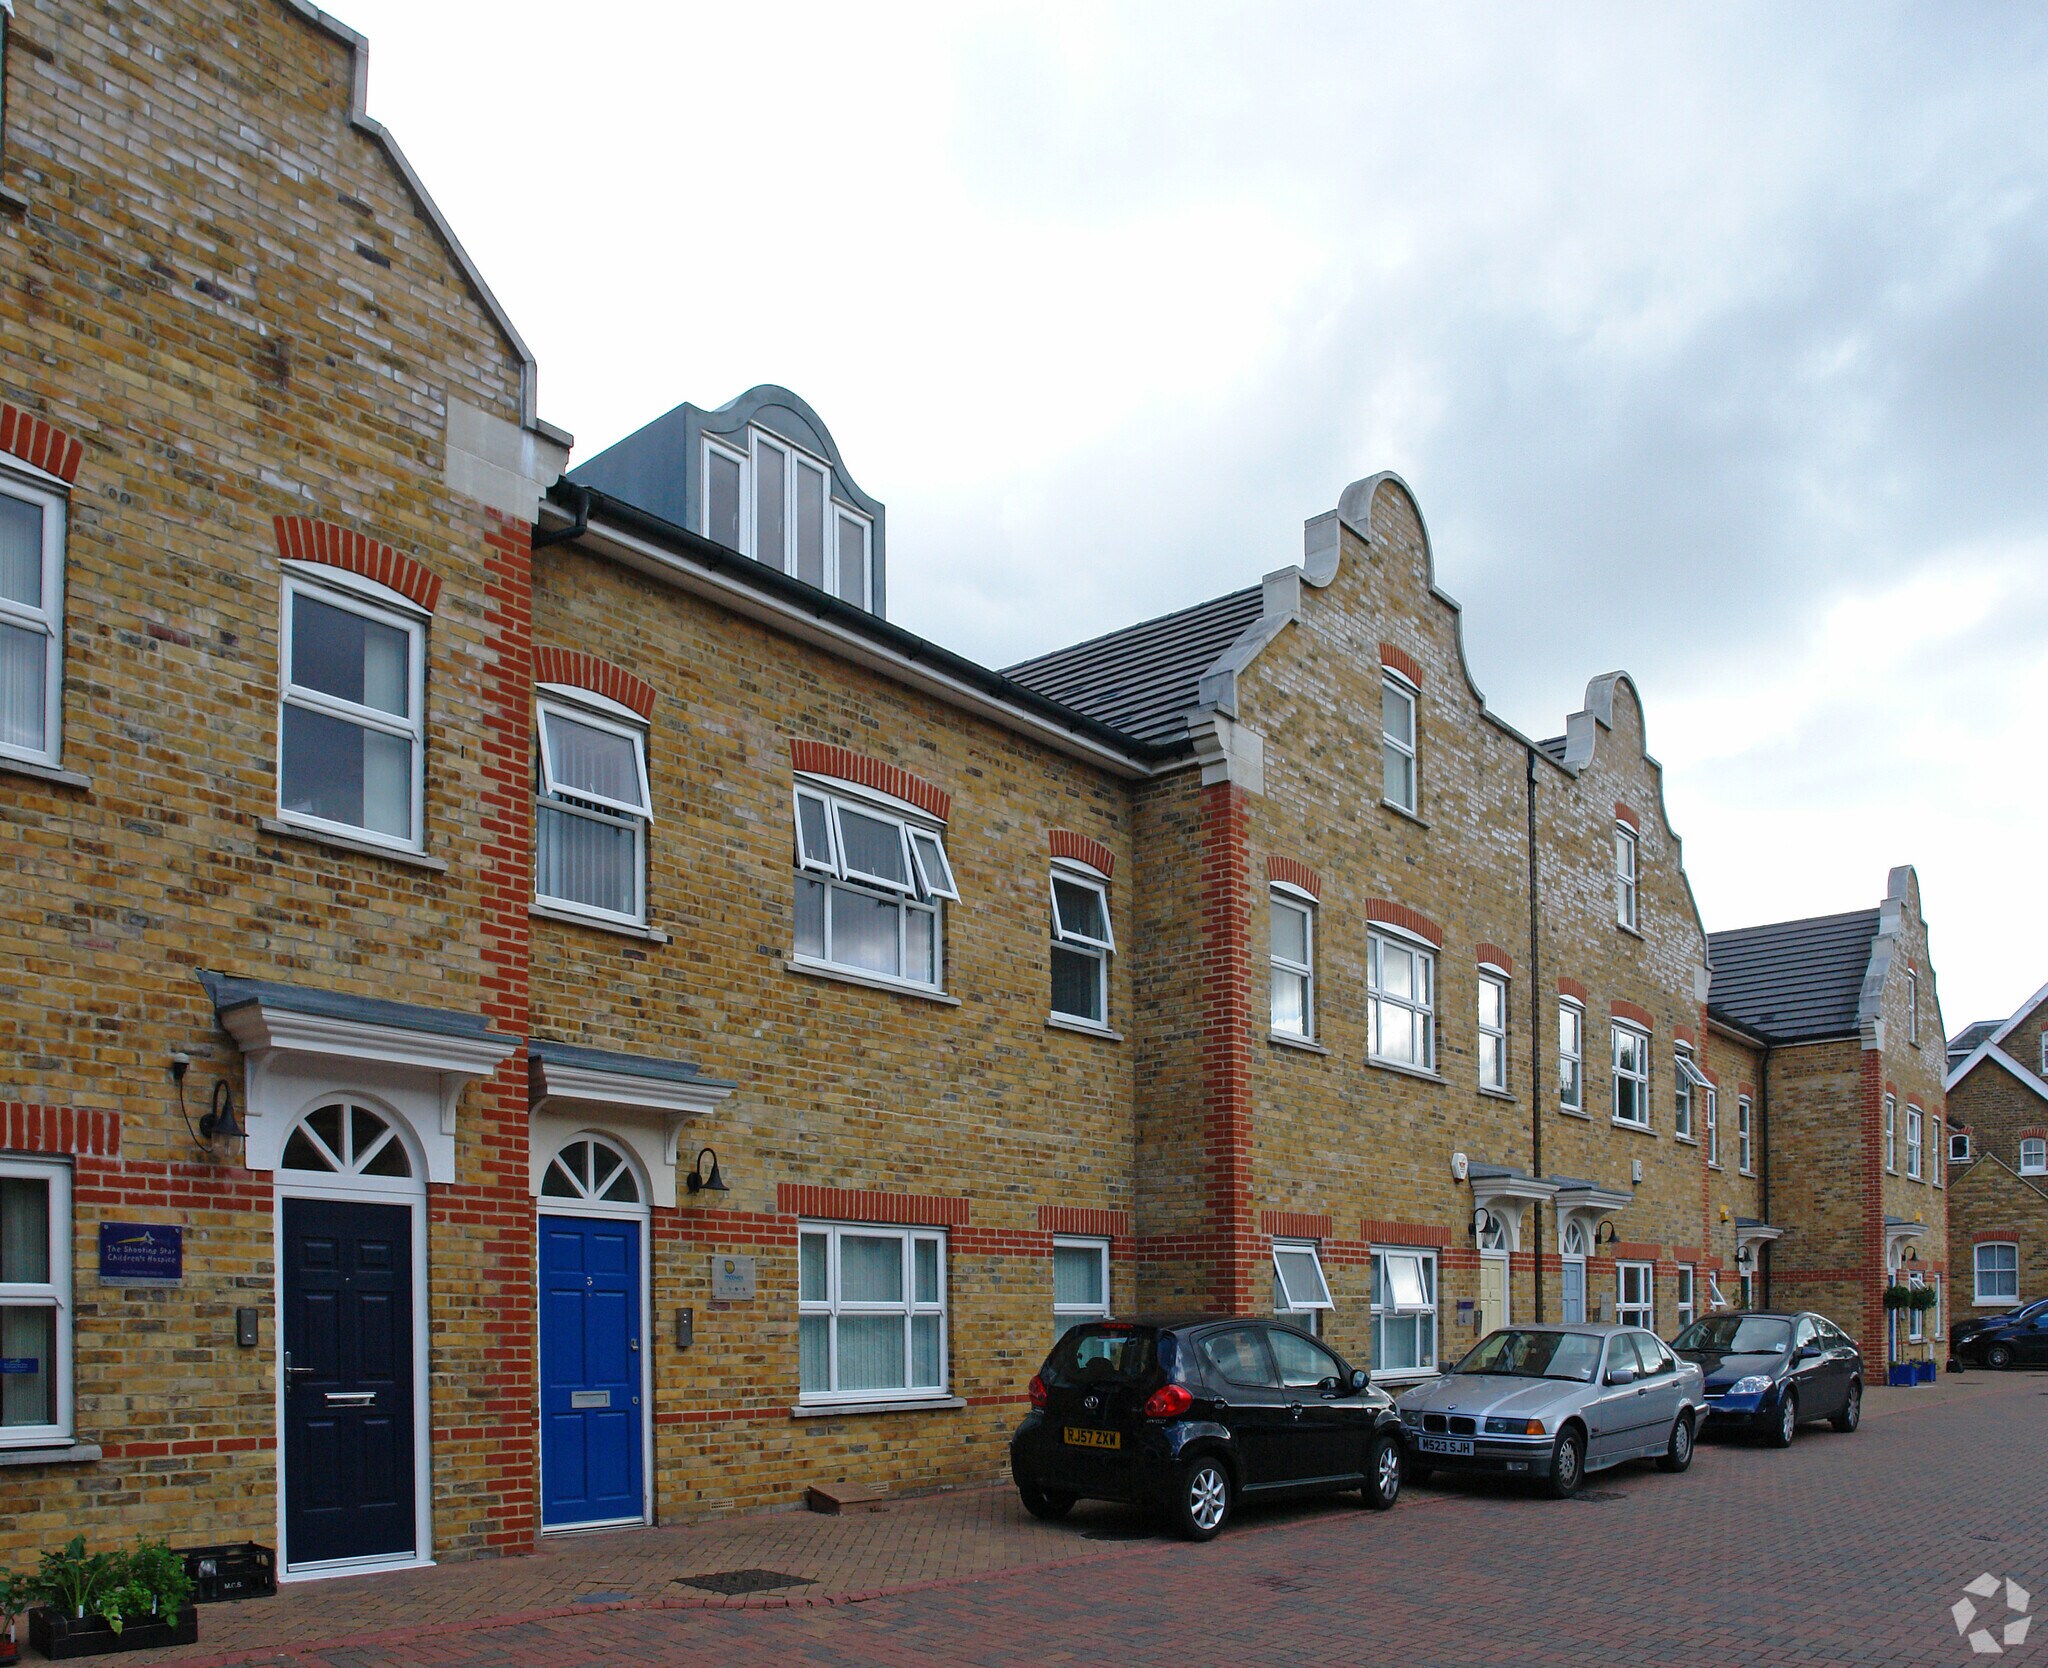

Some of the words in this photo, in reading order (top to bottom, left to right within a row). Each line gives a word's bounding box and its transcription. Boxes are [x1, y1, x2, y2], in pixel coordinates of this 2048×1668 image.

[107, 1245, 122, 1253] The
[123, 1245, 158, 1255] Shooting
[159, 1247, 176, 1255] Star
[107, 1253, 146, 1262] Children's
[147, 1255, 177, 1264] Hospice
[1067, 1428, 1093, 1444] RJ57
[1095, 1431, 1116, 1446] ZXW
[1422, 1438, 1447, 1452] M523
[1449, 1441, 1470, 1454] SJH
